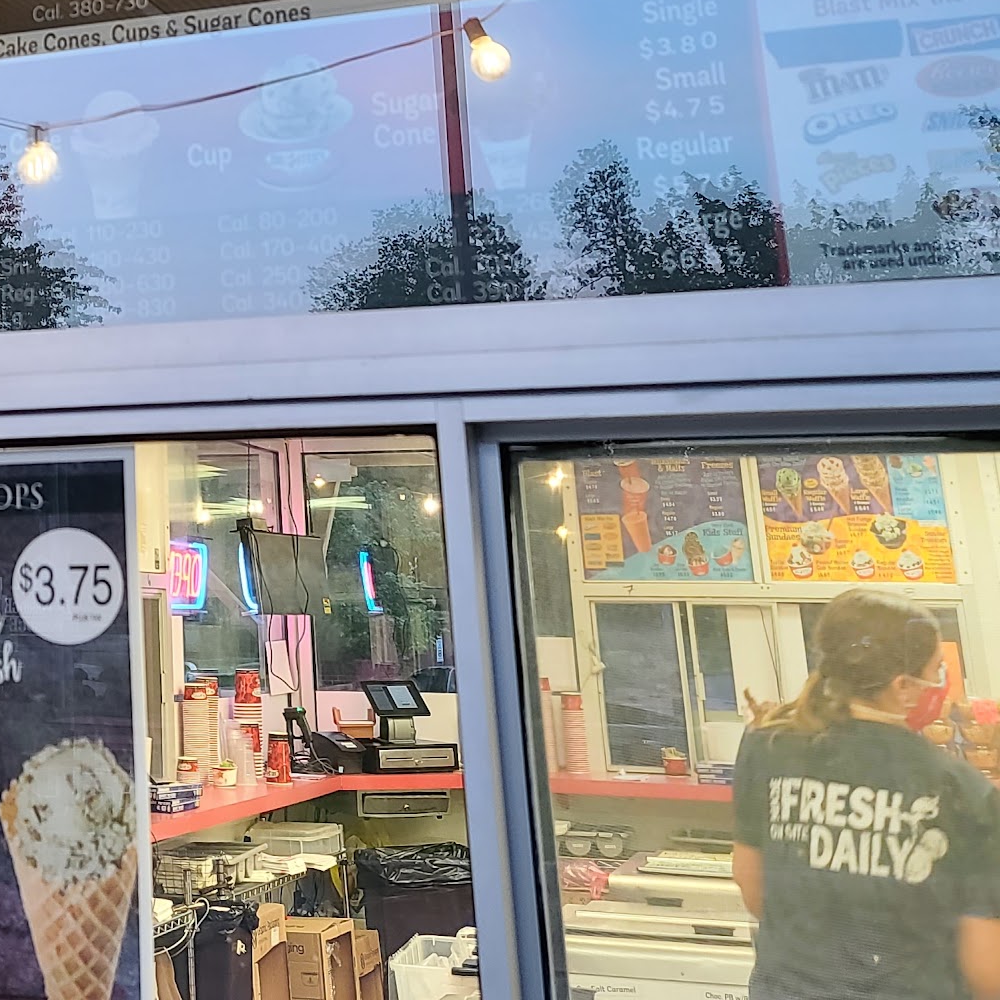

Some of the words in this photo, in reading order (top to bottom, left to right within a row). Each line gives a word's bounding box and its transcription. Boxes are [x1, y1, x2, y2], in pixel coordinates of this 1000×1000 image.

[32, 4, 64, 23] Cal.
[43, 29, 106, 51] Cones,
[112, 21, 160, 46] Cups
[166, 19, 179, 36] &
[184, 11, 241, 36] Sugar
[248, 4, 311, 27] Cones
[640, 31, 718, 60] $3.80
[918, 20, 999, 49] CRUNCH
[655, 60, 727, 91] Small
[646, 95, 726, 125] $4.75
[374, 125, 436, 148] Cone
[636, 132, 734, 165] Regular
[187, 143, 232, 174] Cup
[19, 562, 113, 606] $3.75
[782, 776, 903, 834] FRESH
[810, 824, 912, 881] DAILY
